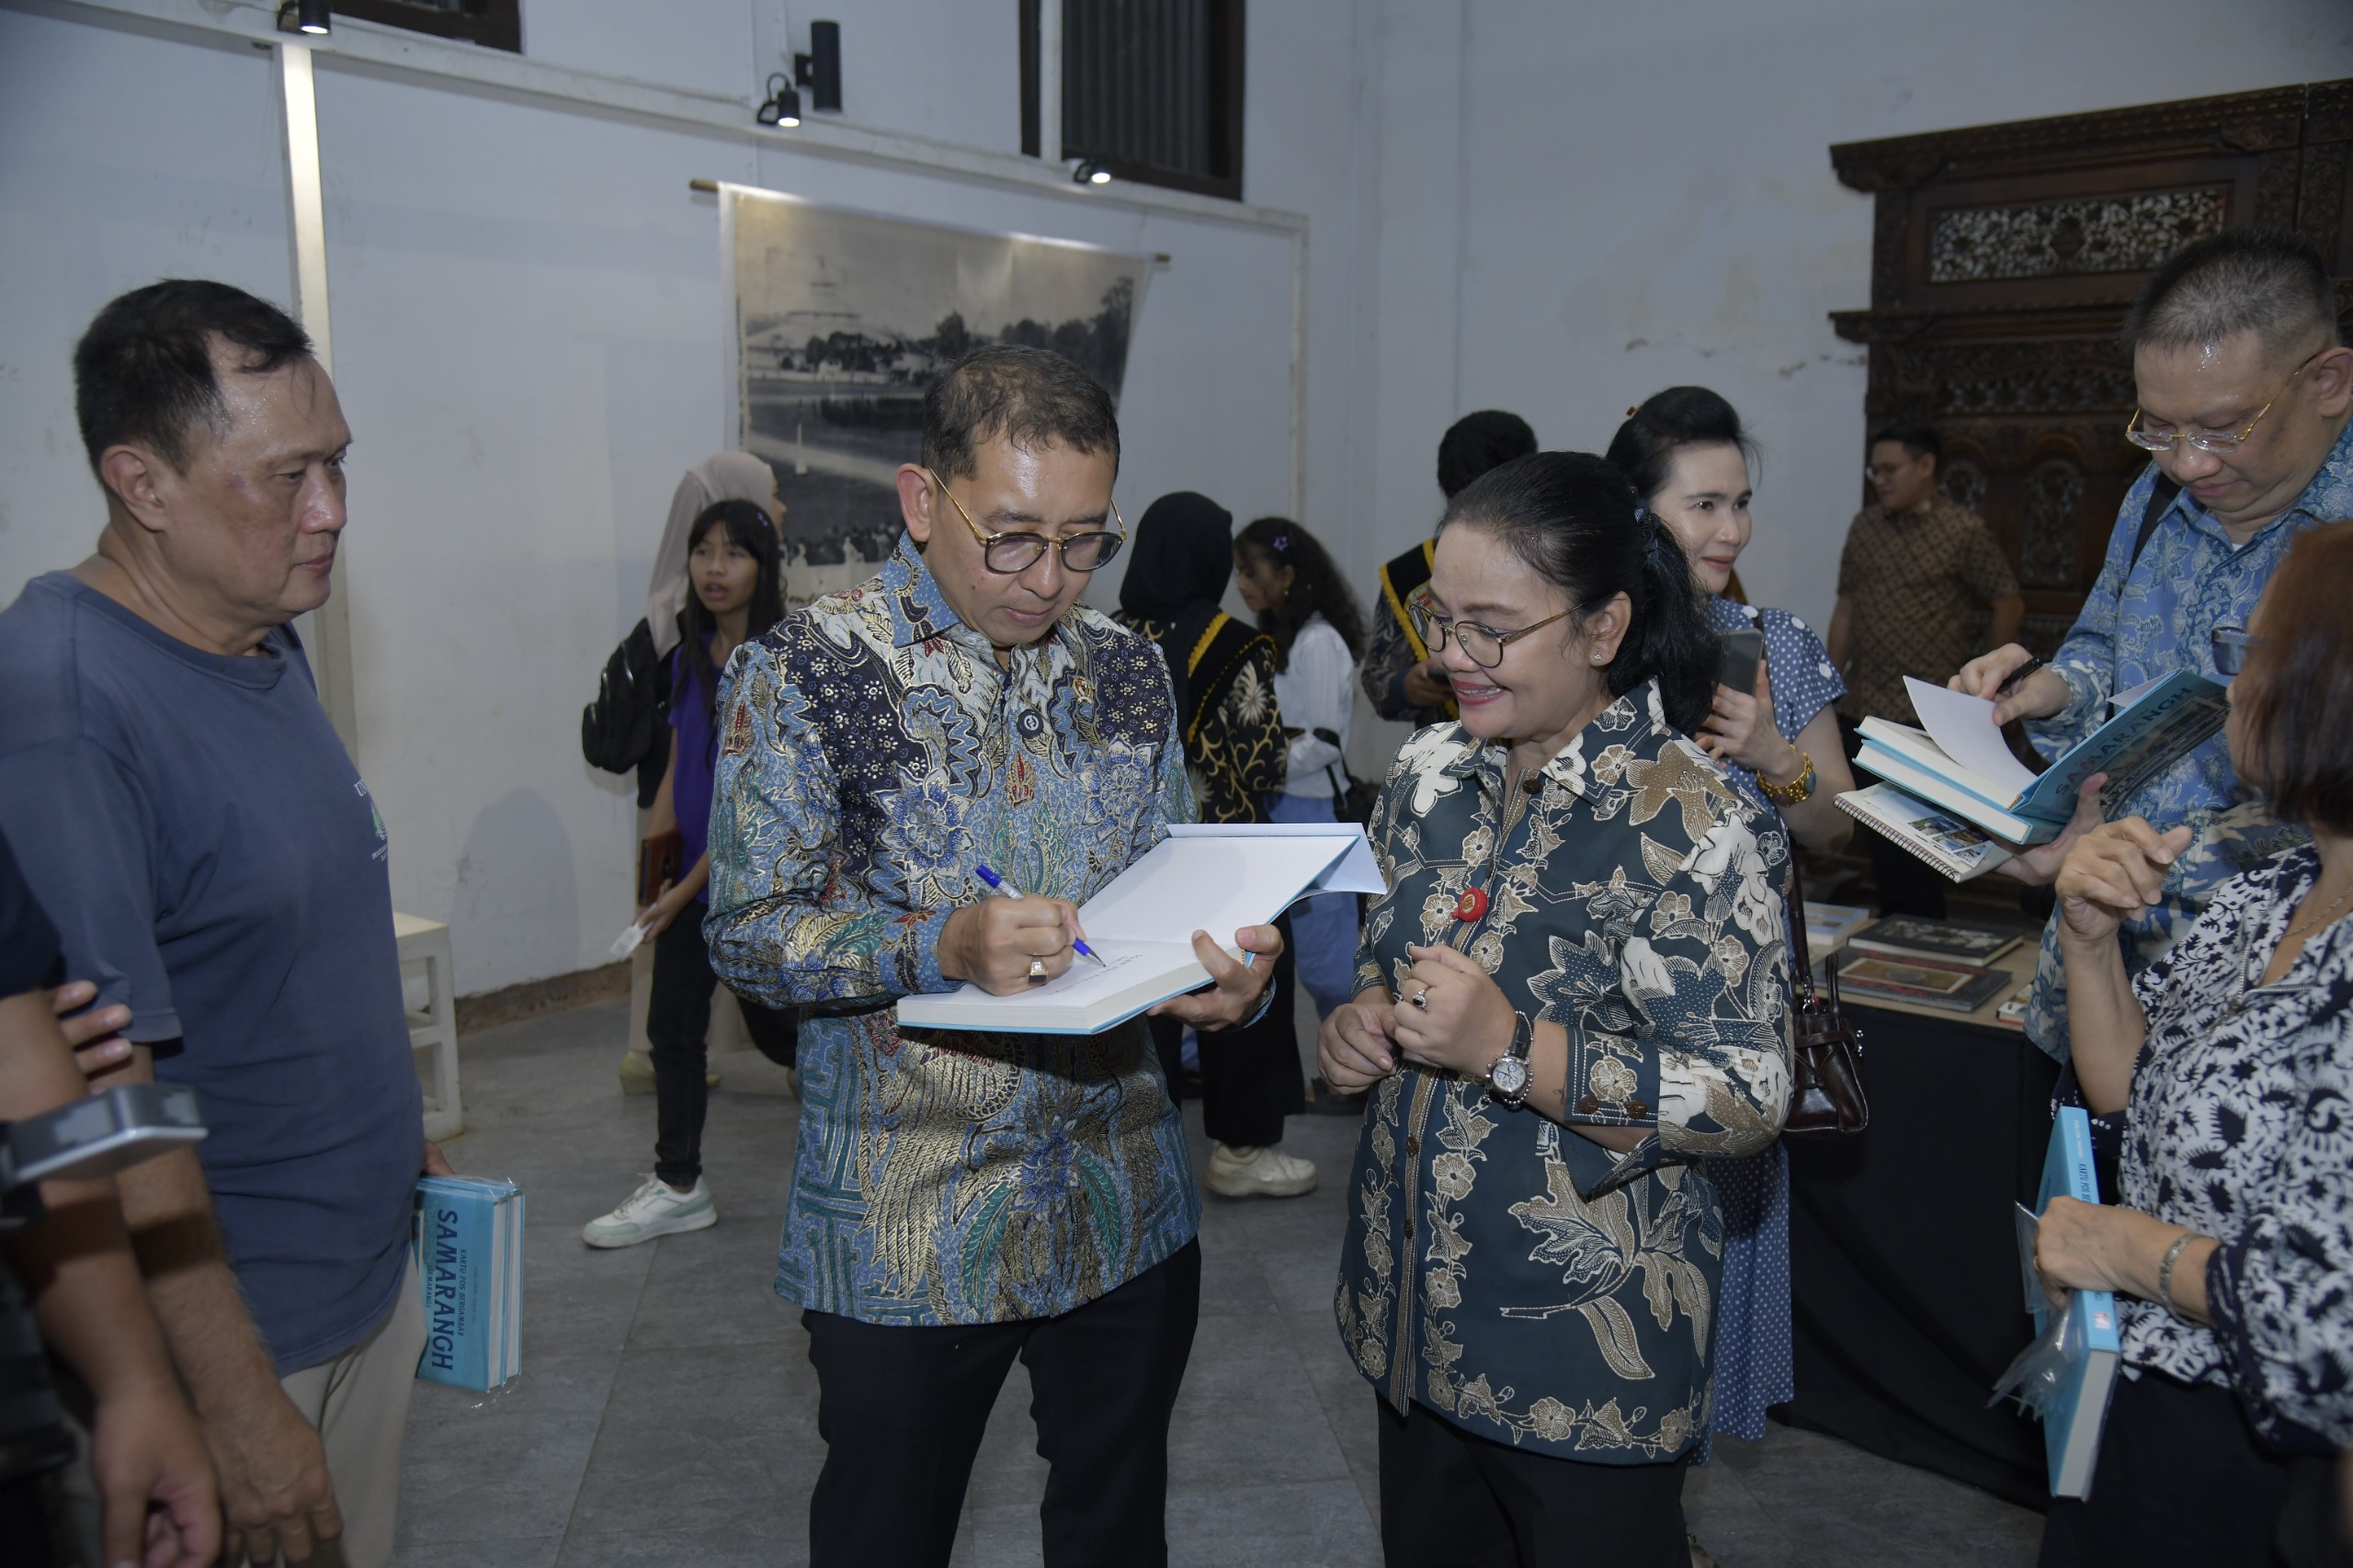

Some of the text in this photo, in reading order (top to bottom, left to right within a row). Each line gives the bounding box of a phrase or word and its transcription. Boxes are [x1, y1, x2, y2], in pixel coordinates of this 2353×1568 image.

[2055, 687, 2193, 795] SAMARANGH
[2078, 1163, 2088, 1181] KARTU
[2080, 1181, 2090, 1193] POS
[431, 1209, 459, 1371] SAMARANGH
[459, 1275, 467, 1290] POS
[457, 1292, 467, 1337] BERGAMBAR
